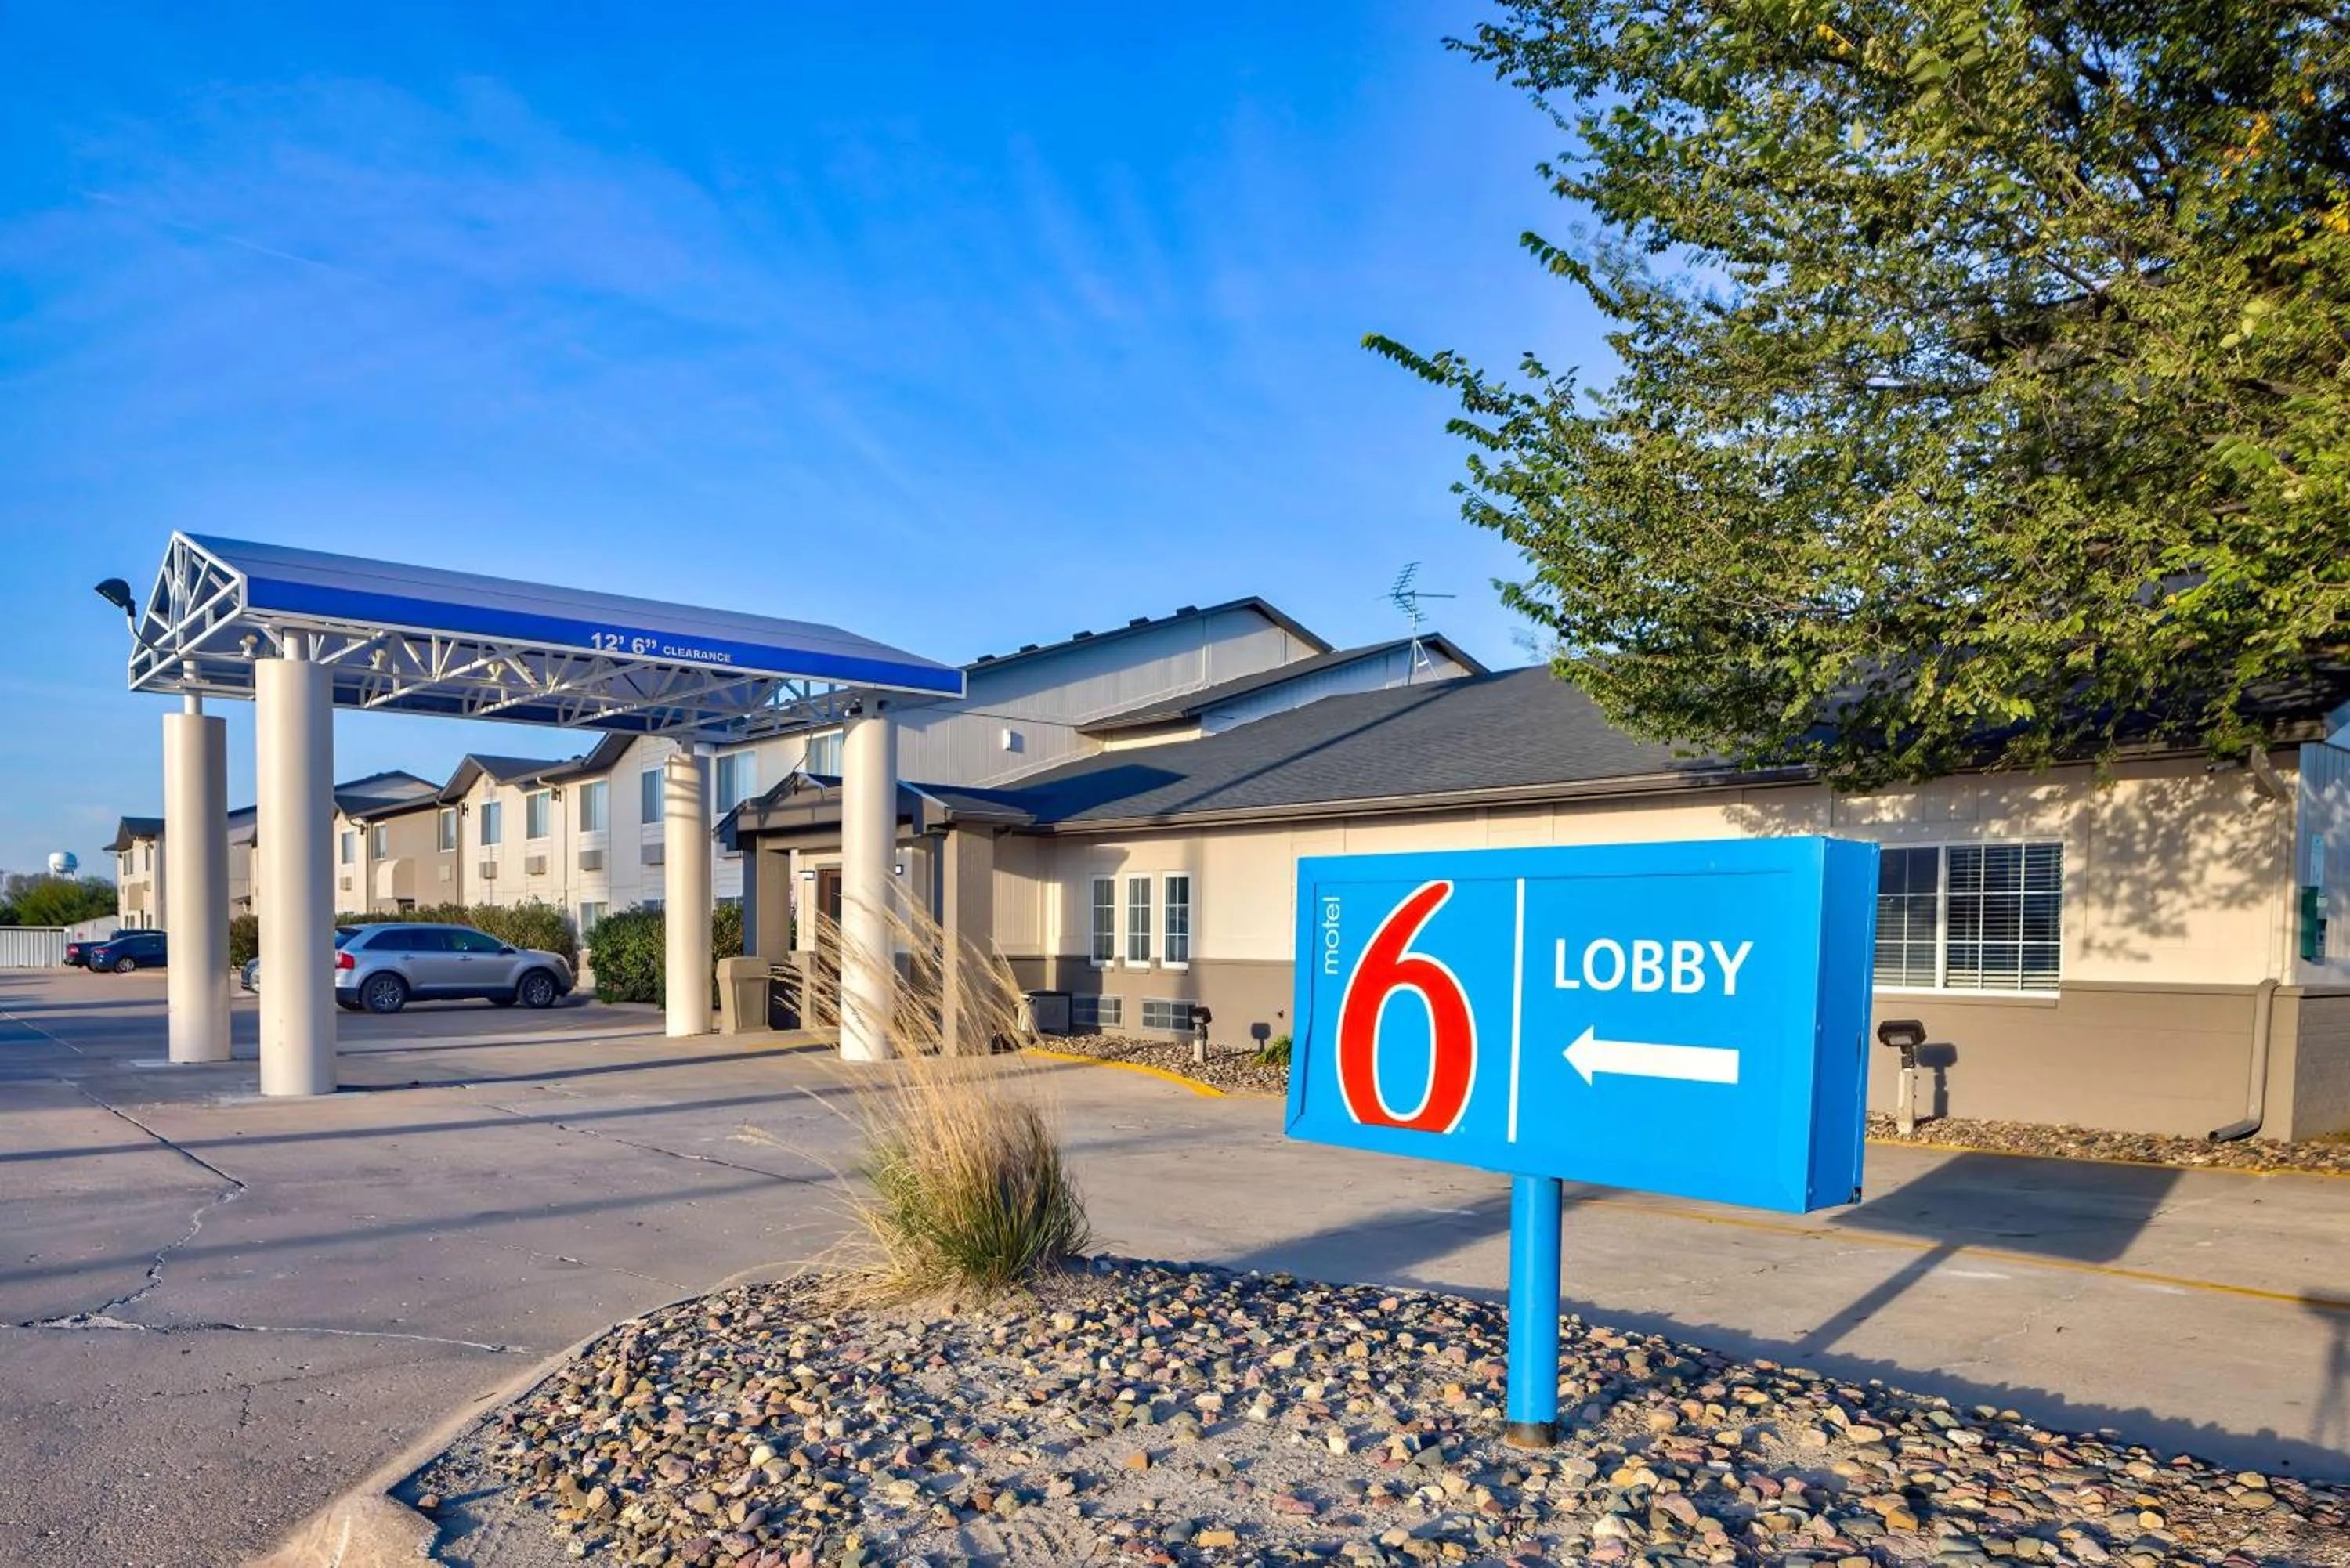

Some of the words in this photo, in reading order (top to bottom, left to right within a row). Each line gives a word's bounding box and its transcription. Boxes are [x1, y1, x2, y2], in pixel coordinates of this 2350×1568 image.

[663, 645, 732, 663] CLEARANCE
[1322, 896, 1341, 975] motel
[1554, 938, 1754, 995] LOBBY
[1336, 880, 1478, 1135] 6
